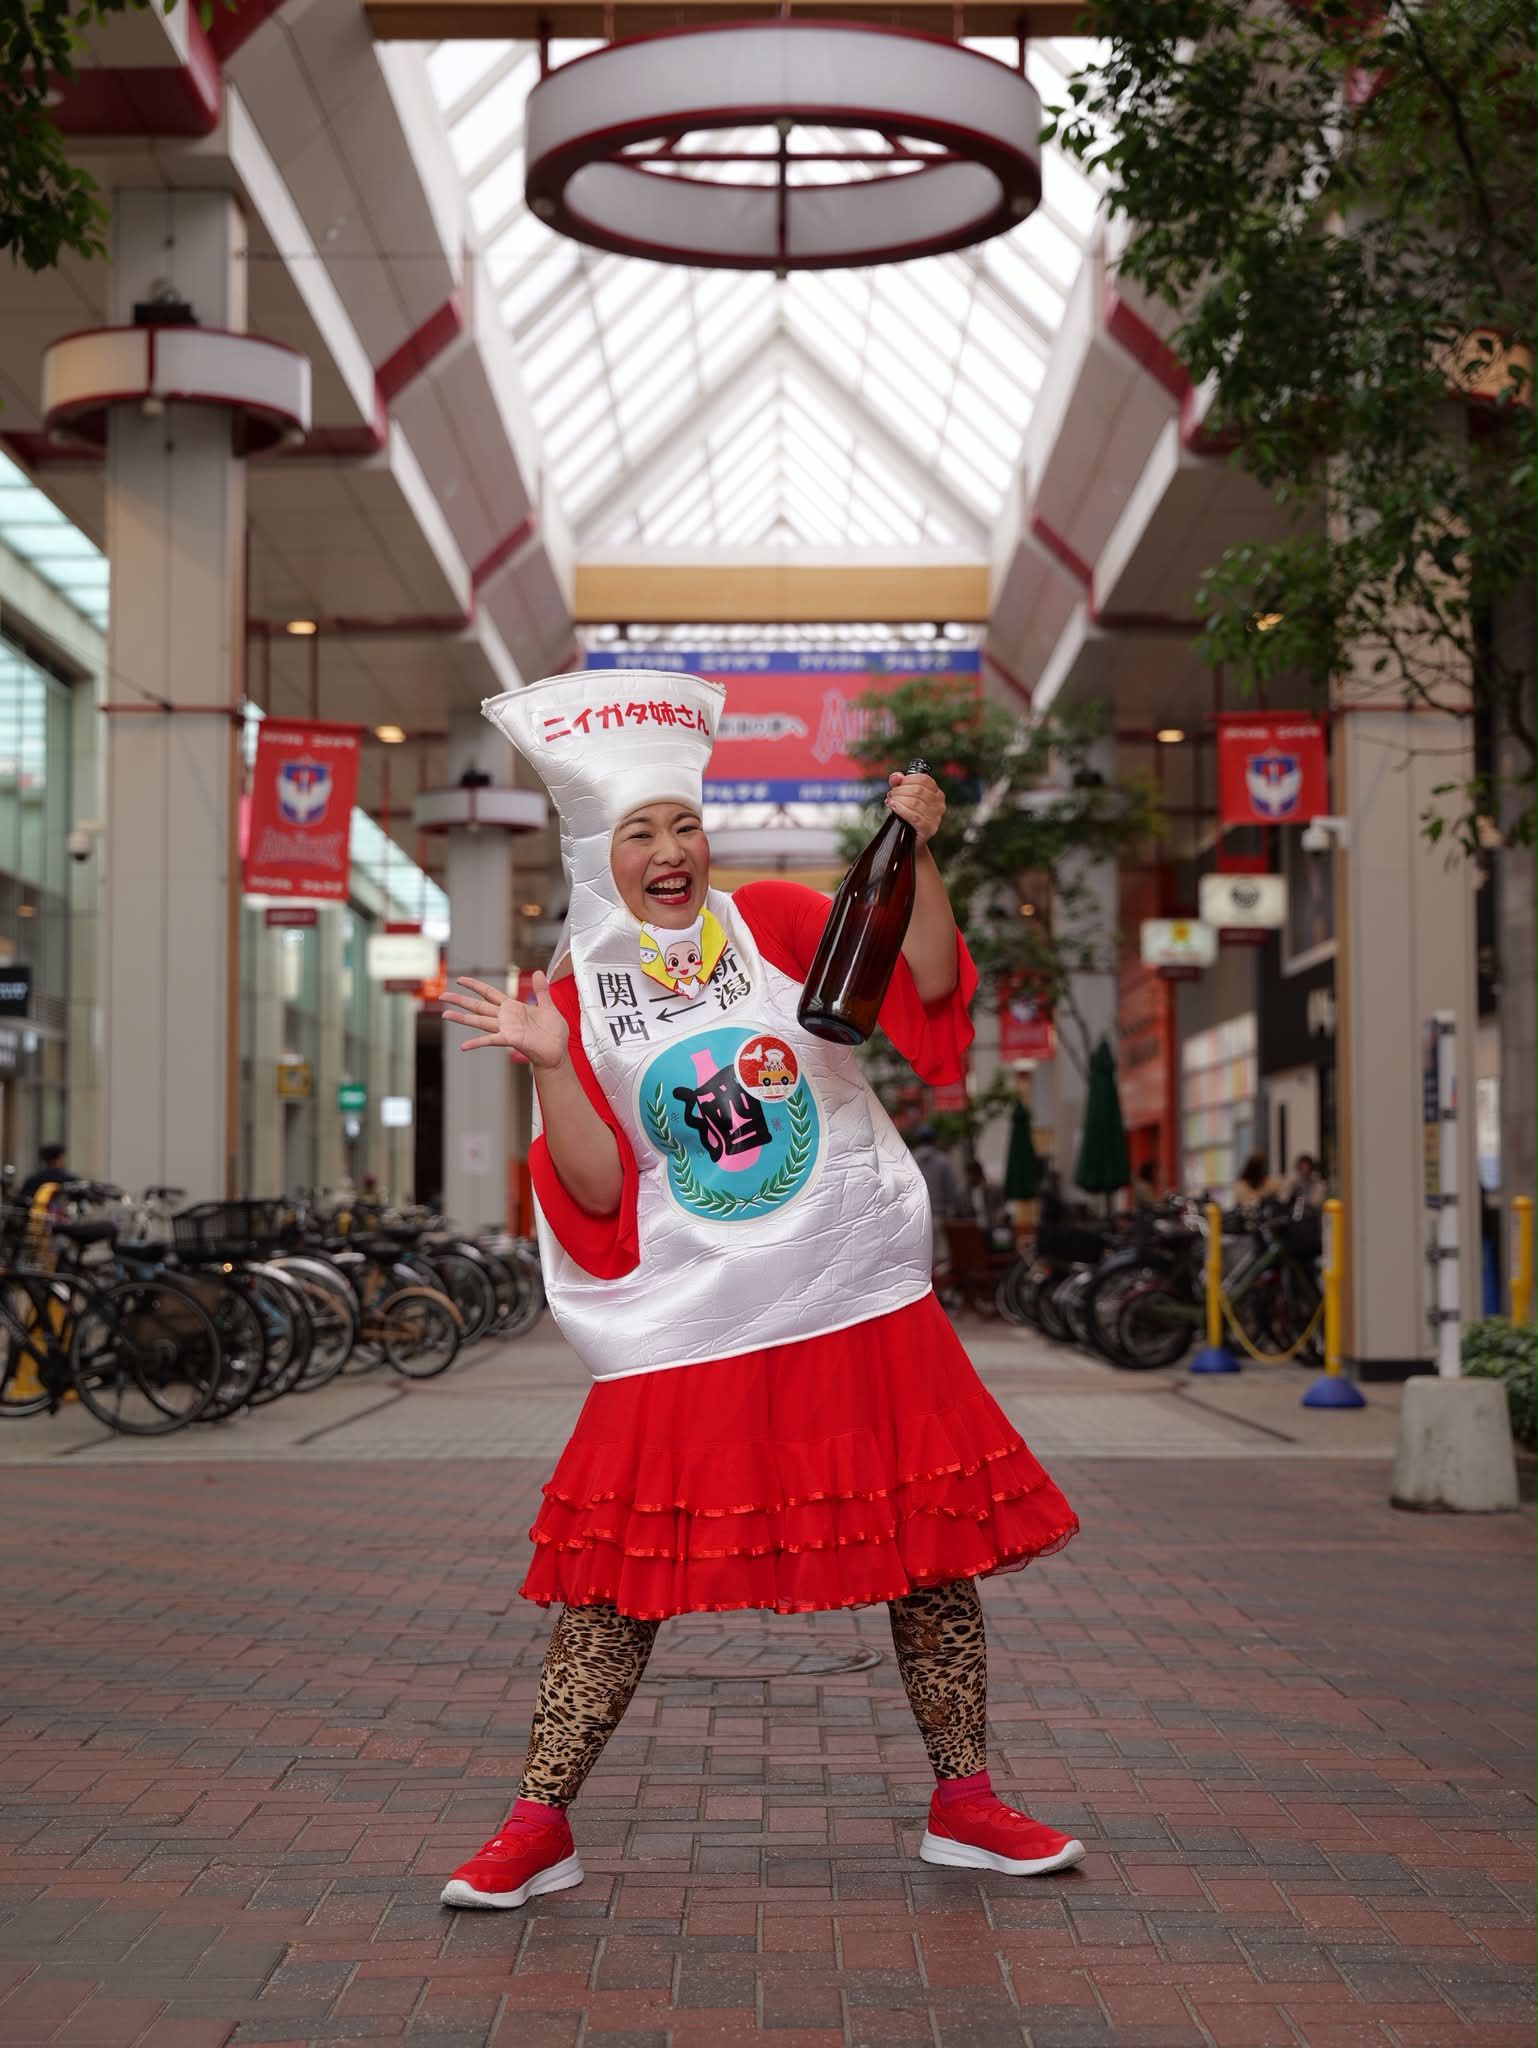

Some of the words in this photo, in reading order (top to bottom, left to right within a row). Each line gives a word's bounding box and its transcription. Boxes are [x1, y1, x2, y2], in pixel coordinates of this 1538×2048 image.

[543, 700, 710, 743] ニイガタ姉さん
[596, 972, 650, 1047] 関西
